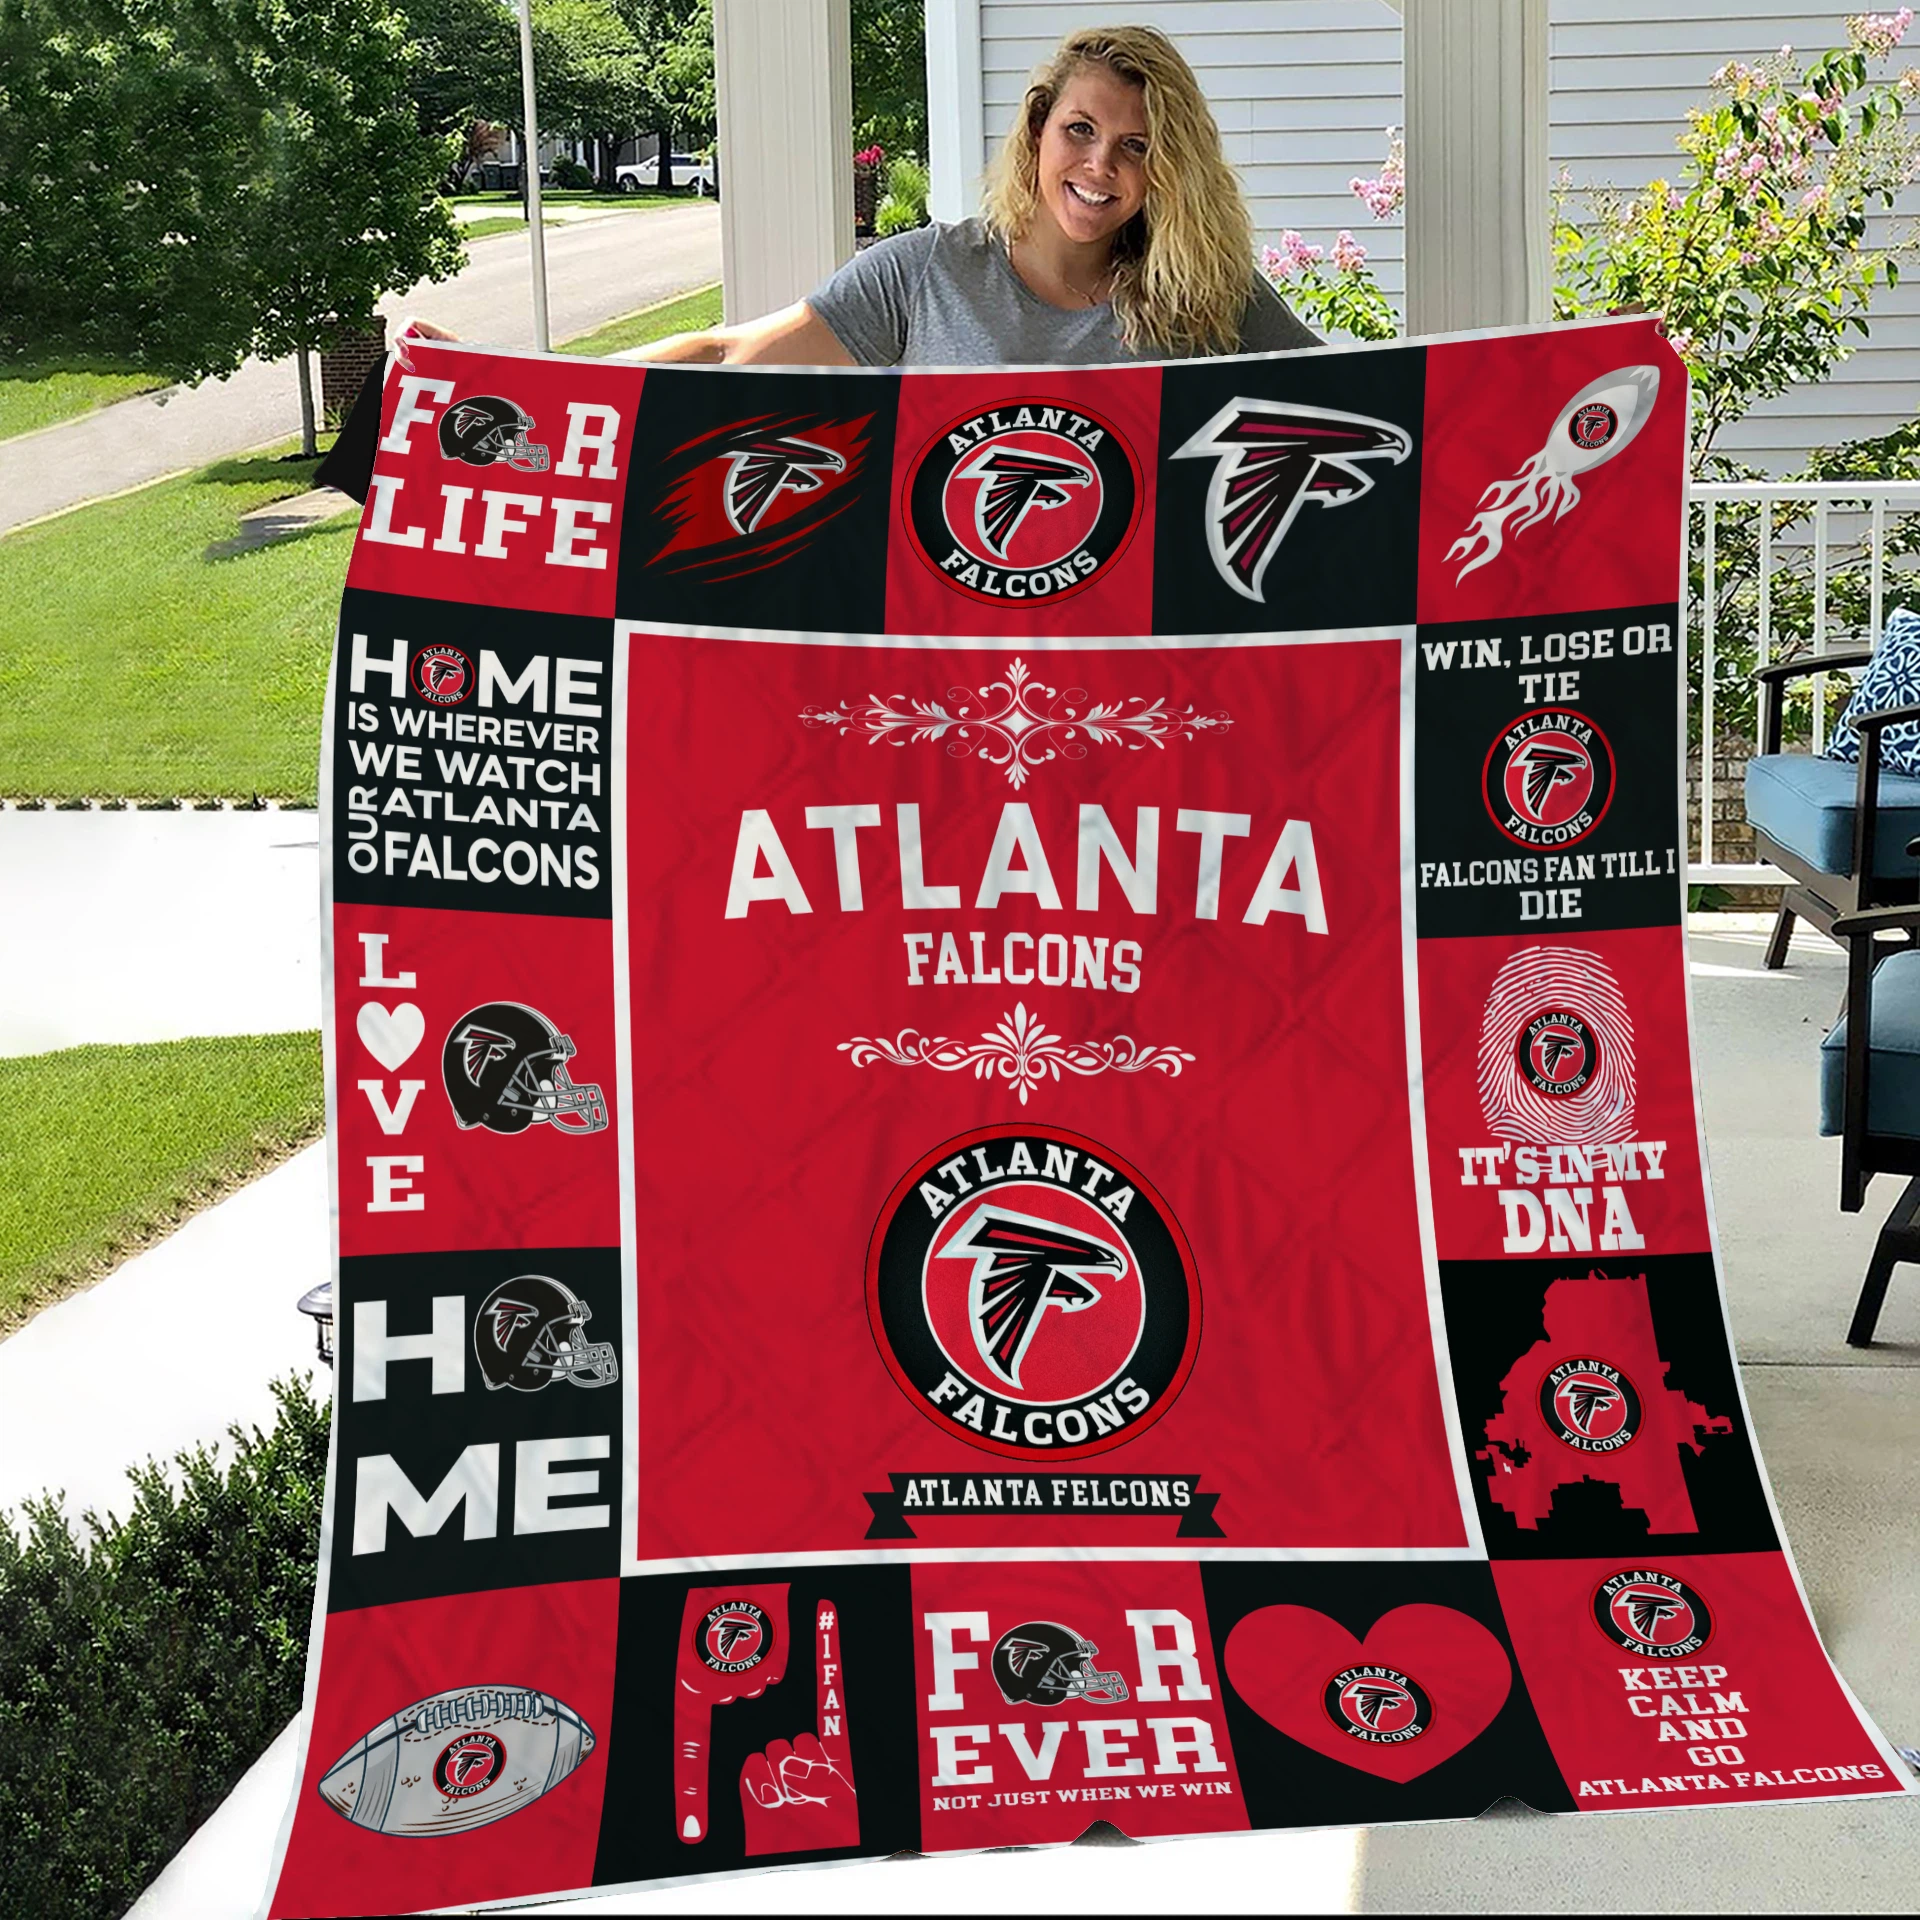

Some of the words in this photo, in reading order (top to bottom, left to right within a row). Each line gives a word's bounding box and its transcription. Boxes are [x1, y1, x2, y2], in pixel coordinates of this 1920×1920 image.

[379, 373, 621, 480] FR
[1577, 405, 1611, 418] ATLANTA
[948, 407, 1106, 455] ATLANTA
[1576, 435, 1609, 448] FALCONS
[362, 477, 613, 569] LIFE
[939, 549, 1099, 597] FALCONS
[422, 647, 465, 665] ATLANTA
[1421, 638, 1511, 671] WIN,
[1519, 628, 1614, 665] LOSE
[1623, 623, 1672, 656] OR
[350, 633, 602, 718] HME
[1519, 671, 1580, 704] TIE
[419, 689, 464, 705] FALCONS
[349, 702, 379, 733] IS
[390, 706, 599, 754] WHEREVER
[1504, 714, 1593, 750] ATLANTA
[348, 739, 422, 780] WE
[435, 749, 600, 796] WATCH
[381, 789, 600, 833] ATLANTA
[1504, 811, 1593, 844] FALCONS
[348, 785, 378, 874] OUR
[385, 832, 600, 890] FALCONS
[724, 802, 1329, 935] ATLANTA
[1420, 858, 1539, 888] FALCONS
[1544, 854, 1596, 882] FAN
[1601, 850, 1661, 878] TILL
[1666, 848, 1675, 874] I
[1519, 888, 1582, 921] DIE
[903, 932, 1143, 993] FALCONS
[1528, 1013, 1583, 1036] ATLANTA
[1532, 1074, 1587, 1095] FALCONS
[1458, 1141, 1541, 1186] IT'S
[1549, 1144, 1597, 1184] IN
[1601, 1140, 1667, 1182] MY
[918, 1141, 1136, 1223] ATLANTA
[1498, 1186, 1645, 1254] DNA
[1549, 1360, 1620, 1386] ATLANTA
[927, 1371, 1151, 1445] FALCONS
[1561, 1428, 1633, 1452] FALCONS
[903, 1479, 1043, 1507] ATLANTA
[1051, 1479, 1191, 1507] FELCONS
[1602, 1571, 1684, 1596] ATLANTA
[706, 1602, 762, 1623] ATLANTA
[705, 1654, 761, 1673] FALCONS
[924, 1609, 1212, 1711] FR
[1621, 1636, 1704, 1658] FALCONS
[1334, 1667, 1408, 1688] ATLANTA
[1618, 1665, 1728, 1691] KEEP
[1627, 1691, 1750, 1718] CALM
[448, 1735, 496, 1755] ATLANTA
[1347, 1724, 1423, 1743] FALCONS
[1658, 1718, 1748, 1742] AND
[930, 1716, 1227, 1786] EVER
[1686, 1745, 1746, 1767] GO
[442, 1777, 491, 1796] FALCONS
[933, 1795, 982, 1811] NOT
[988, 1791, 1050, 1808] JUST
[1056, 1787, 1132, 1802] WHEN
[1136, 1784, 1176, 1798] WE
[1180, 1781, 1233, 1796] WIN
[1578, 1772, 1727, 1797] ATLANTA
[1731, 1764, 1885, 1788] FALCONS
